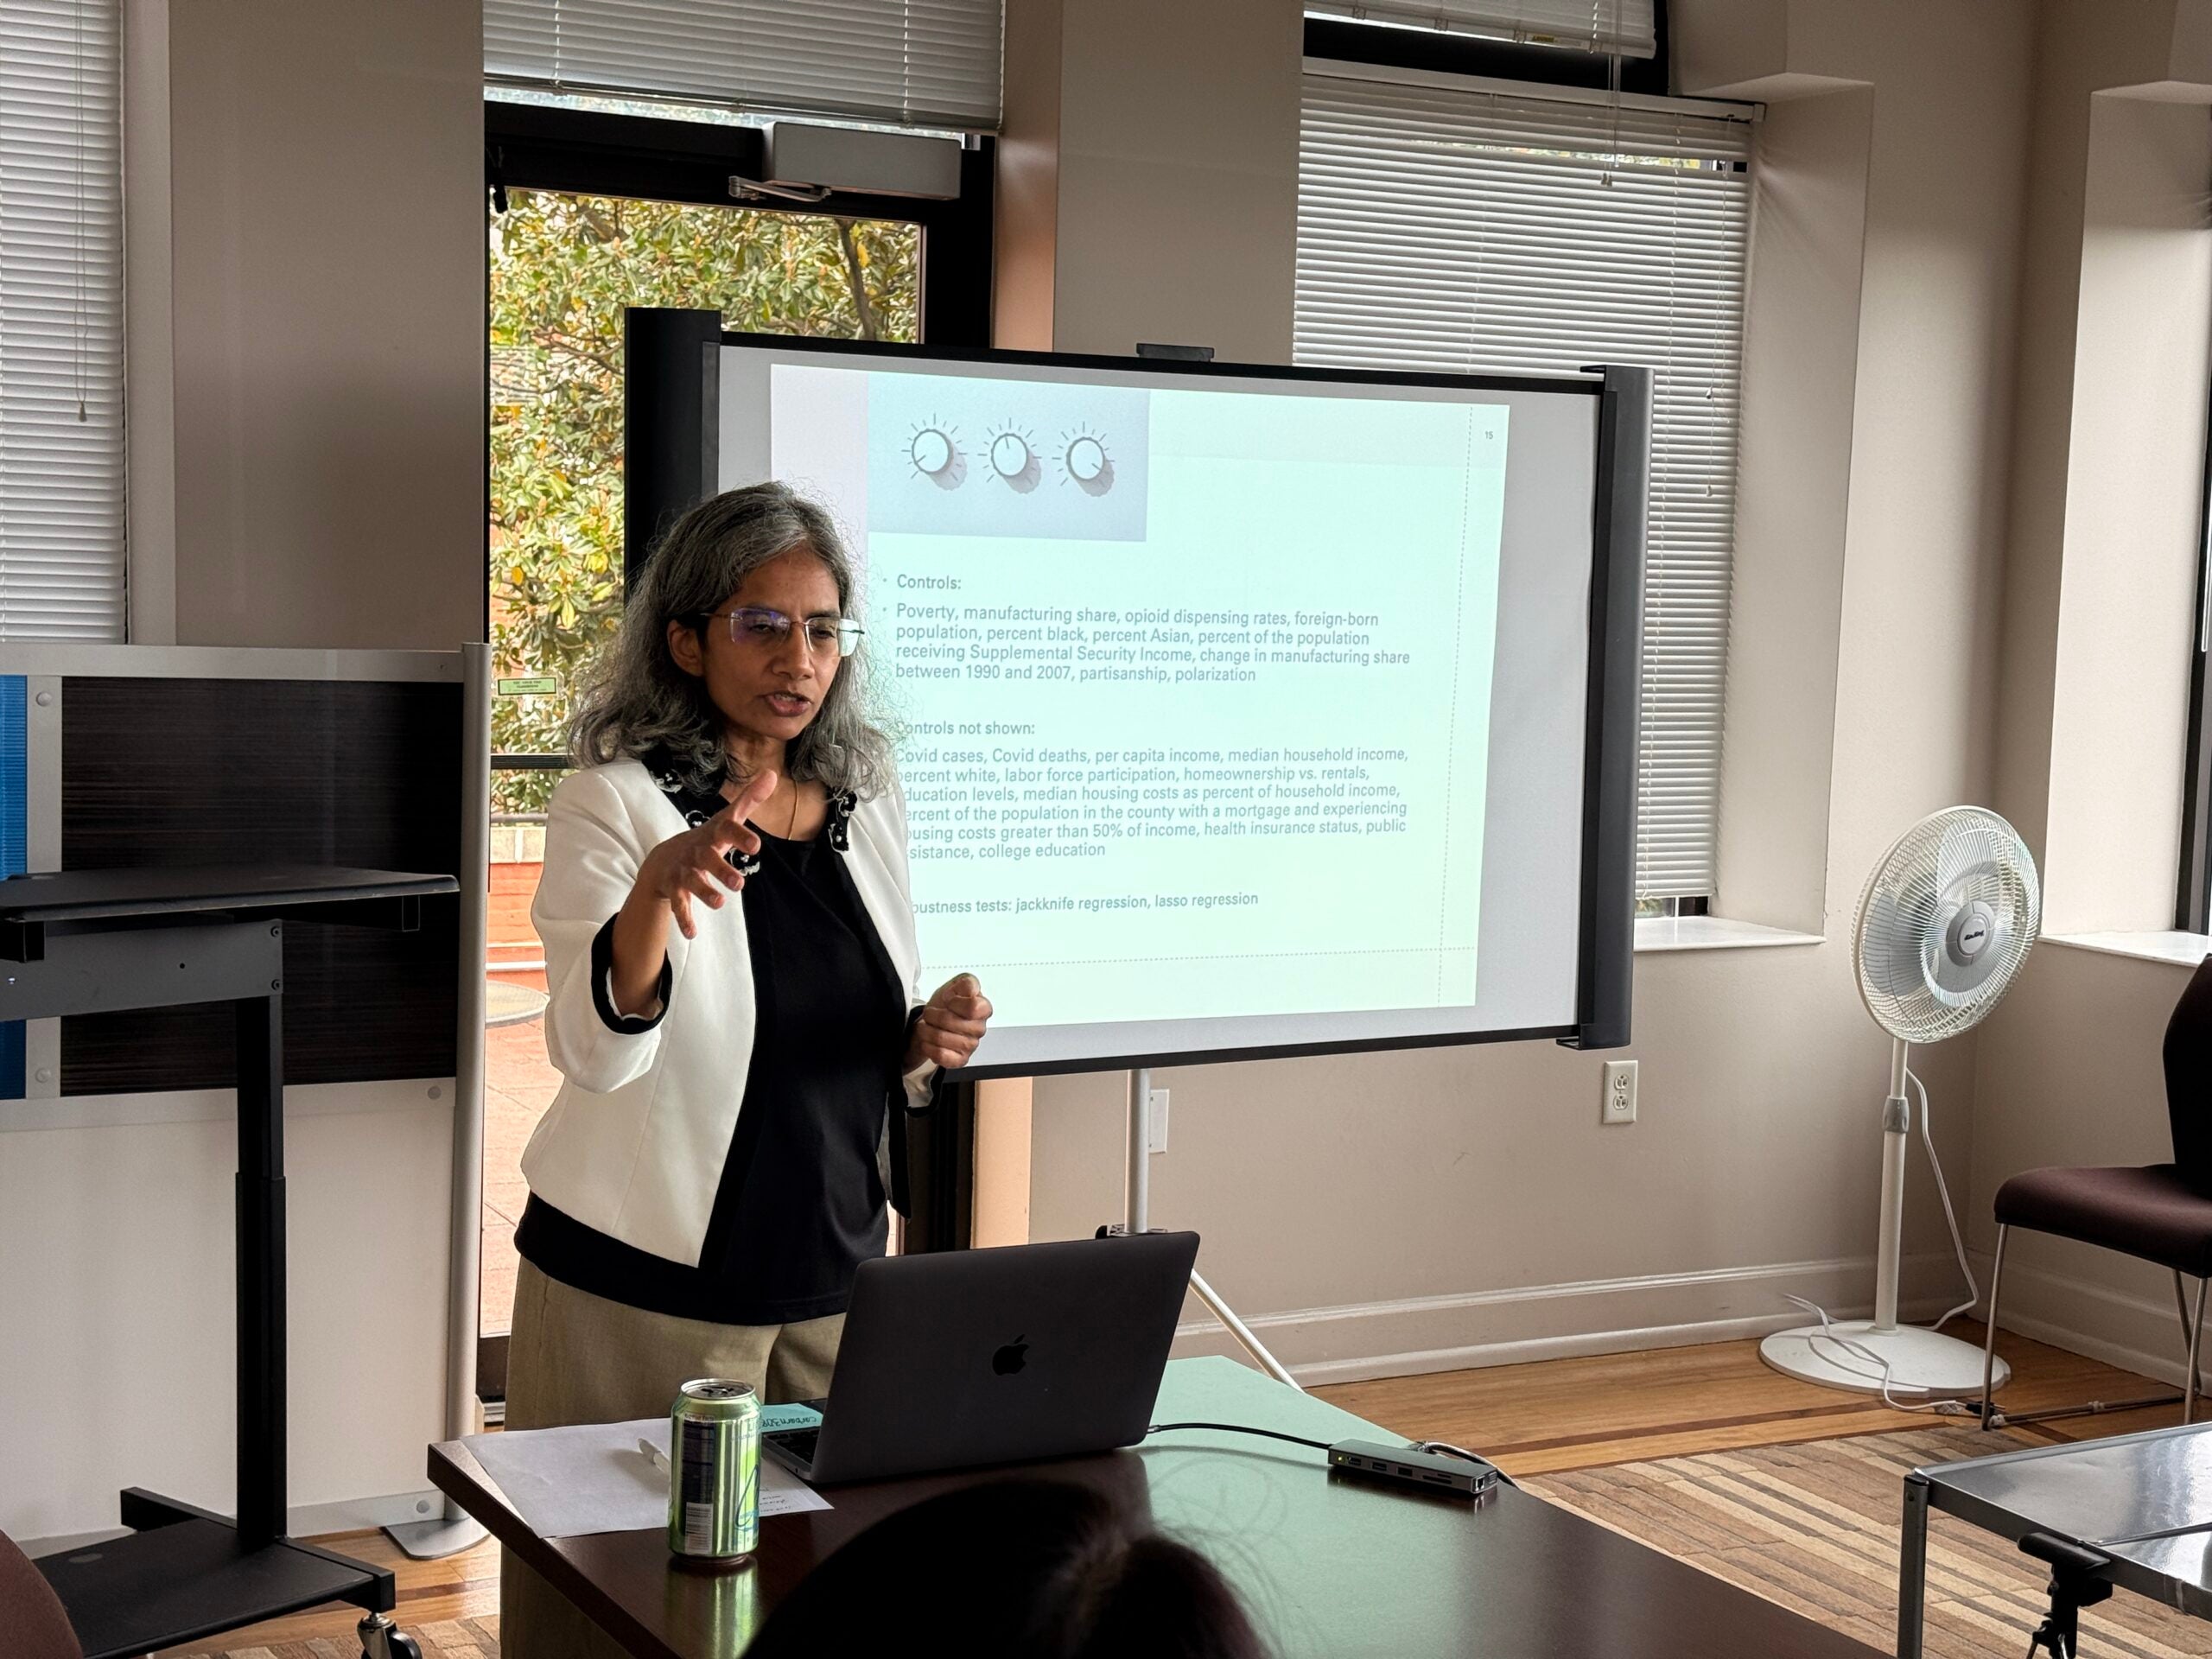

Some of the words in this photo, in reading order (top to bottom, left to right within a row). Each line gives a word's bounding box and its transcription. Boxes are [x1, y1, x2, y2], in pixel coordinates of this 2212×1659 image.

[897, 574, 961, 589] Controls:
[897, 603, 958, 622] Poverty,
[964, 605, 1071, 625] manufacturing
[1077, 607, 1120, 624] share,
[1125, 608, 1169, 626] opioid
[1174, 609, 1249, 627] dispensing
[1254, 613, 1290, 626] rates,
[1294, 611, 1378, 629] foreign-born
[897, 624, 982, 641] population,
[988, 627, 1042, 643] percent
[1047, 626, 1088, 643] black,
[1093, 630, 1147, 645] percent
[1150, 628, 1193, 645] Asian,
[1198, 632, 1250, 646] percent
[1255, 630, 1268, 644] of
[1272, 630, 1293, 644] the
[1298, 631, 1369, 647] population
[897, 644, 965, 662] receiving
[970, 644, 1072, 662] Supplemental
[1077, 645, 1136, 664] Security
[1141, 647, 1196, 663] Income,
[1200, 648, 1249, 664] change
[1255, 648, 1266, 662] in
[1271, 649, 1369, 666] manufacturing
[1374, 650, 1409, 664] share
[896, 664, 960, 678] between
[966, 664, 1000, 678] 1990
[1005, 665, 1032, 678] and
[1037, 665, 1075, 681] 2007,
[1080, 666, 1171, 683] partisanship,
[1175, 667, 1255, 684] polarization
[959, 722, 982, 734] not
[985, 721, 1034, 734] shown:
[943, 752, 987, 764] cases,
[993, 748, 1033, 762] Covid
[1039, 748, 1090, 764] deaths,
[1096, 752, 1119, 765] per
[1122, 748, 1165, 765] capita
[1170, 747, 1224, 763] income,
[1229, 748, 1279, 761] median
[1284, 747, 1353, 761] household
[1357, 747, 1408, 762] income,
[955, 768, 1000, 784] white,
[1006, 767, 1043, 782] labor
[1046, 767, 1083, 781] force
[1088, 767, 1179, 785] participation,
[1185, 766, 1295, 783] homeownership
[1299, 770, 1317, 779] vs.
[1322, 766, 1369, 780] rentals,
[905, 787, 968, 801] ducation
[973, 786, 1018, 802] levels,
[1024, 786, 1077, 800] median
[1083, 785, 1138, 803] housing
[1143, 787, 1179, 799] costs
[1183, 789, 1198, 798] as
[1203, 786, 1254, 802] percent
[1258, 784, 1272, 798] of
[1275, 784, 1344, 798] household
[1349, 784, 1400, 798] income,
[906, 807, 951, 821] ercent
[955, 806, 969, 821] of
[974, 806, 996, 820] the
[1001, 805, 1078, 823] population
[1084, 804, 1096, 819] in
[1101, 804, 1122, 819] the
[1128, 806, 1174, 821] county
[1179, 804, 1208, 817] with
[1213, 807, 1220, 817] a
[1225, 805, 1290, 820] mortgage
[1294, 802, 1319, 816] and
[1324, 801, 1407, 818] experiencing
[907, 825, 954, 842] ousing
[958, 827, 995, 839] costs
[1001, 826, 1052, 842] greater
[1057, 824, 1088, 838] than
[1093, 823, 1122, 837] 50%
[1128, 823, 1141, 836] of
[1146, 823, 1199, 837] income,
[1205, 822, 1246, 835] health
[1251, 821, 1315, 835] insurance
[1319, 821, 1362, 834] status,
[1366, 818, 1406, 836] public
[907, 844, 975, 860] sistance,
[979, 843, 1031, 861] college
[1036, 842, 1105, 857] education
[912, 901, 972, 913] bustness
[976, 900, 1011, 912] tests:
[1015, 897, 1074, 914] jackknife
[1078, 895, 1151, 912] regression,
[1155, 895, 1188, 907] lasso
[1192, 892, 1258, 909] regression
